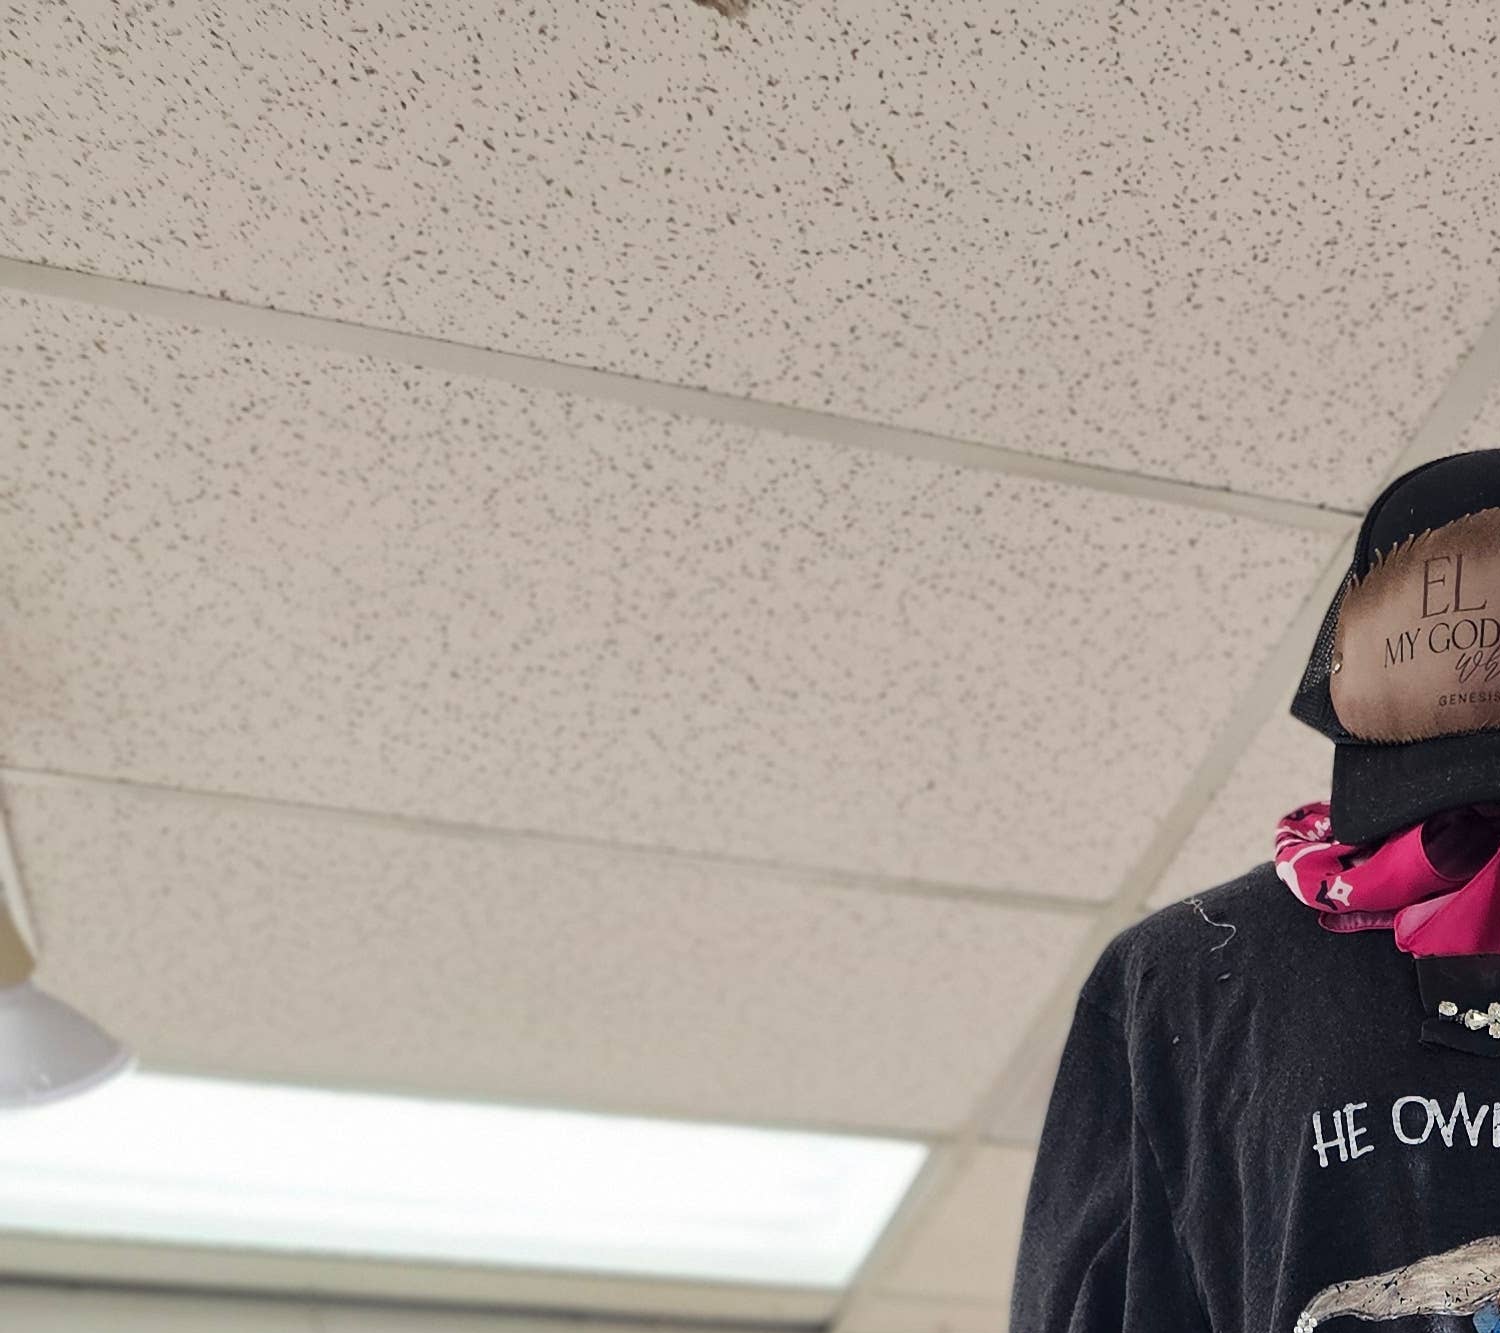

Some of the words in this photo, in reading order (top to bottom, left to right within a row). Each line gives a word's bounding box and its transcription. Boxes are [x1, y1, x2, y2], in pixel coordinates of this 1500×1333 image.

[1422, 553, 1488, 619] EL
[1384, 628, 1421, 669] MY
[1428, 617, 1500, 654] GOD
[1312, 1102, 1375, 1168] HE
